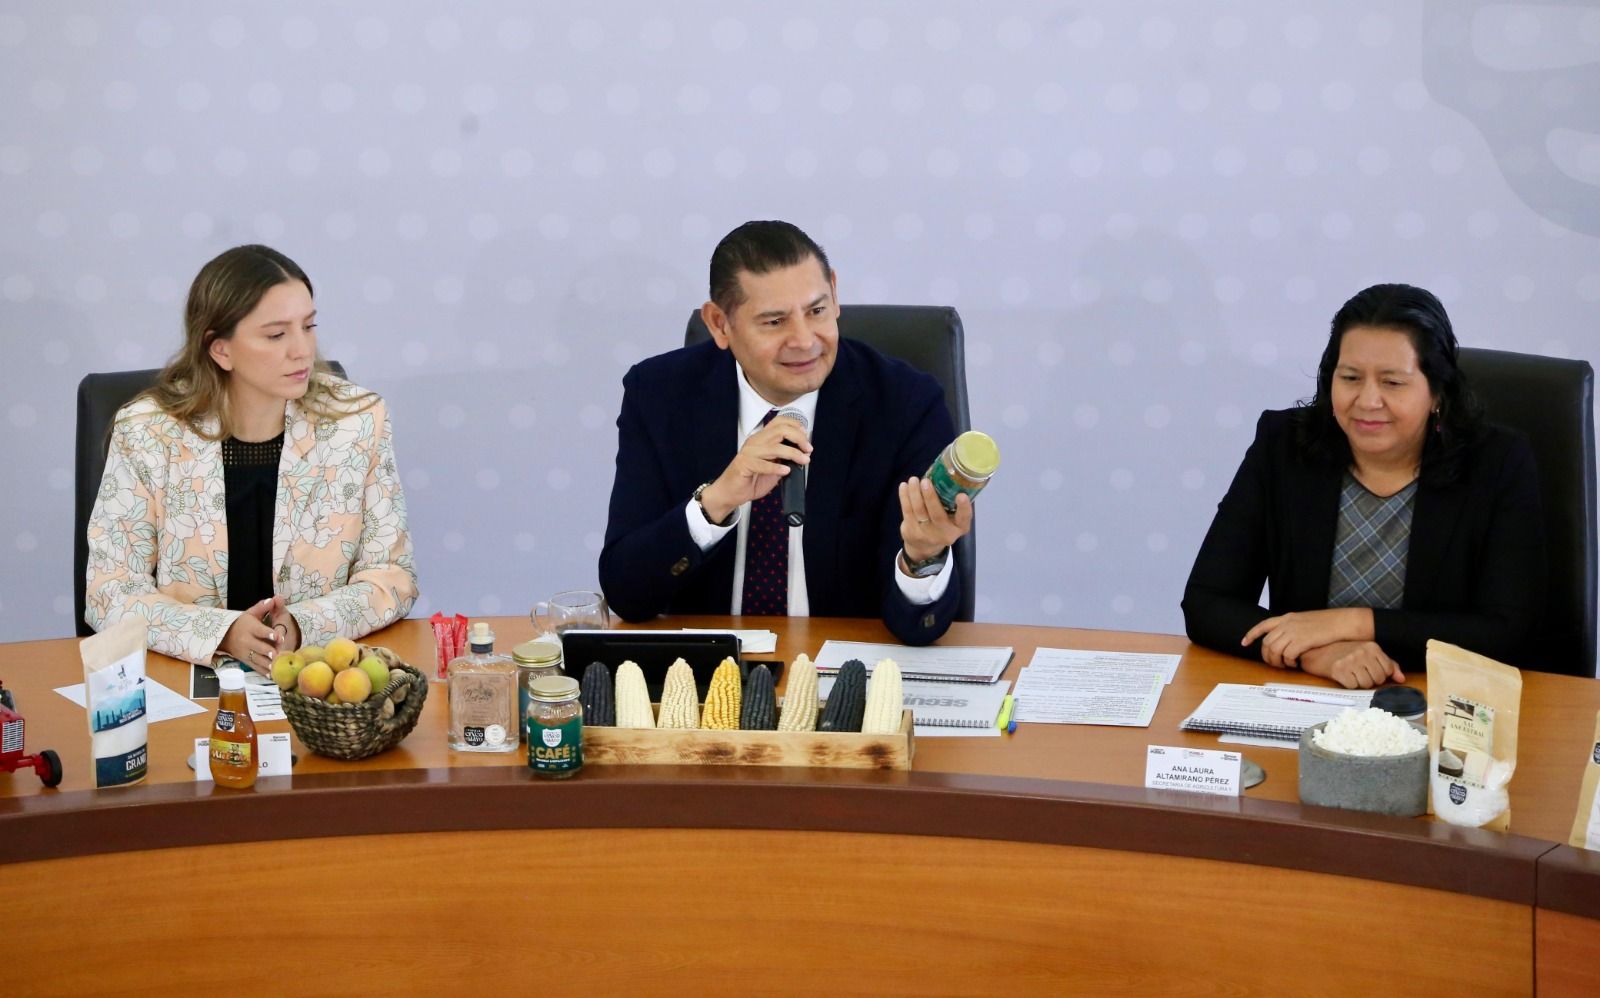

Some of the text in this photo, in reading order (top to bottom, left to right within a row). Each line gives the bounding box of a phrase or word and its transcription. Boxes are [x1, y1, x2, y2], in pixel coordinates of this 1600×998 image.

[536, 744, 570, 759] CAFÉ
[1189, 767, 1214, 775] LAURA
[1156, 773, 1203, 783] ALTAMIRANO
